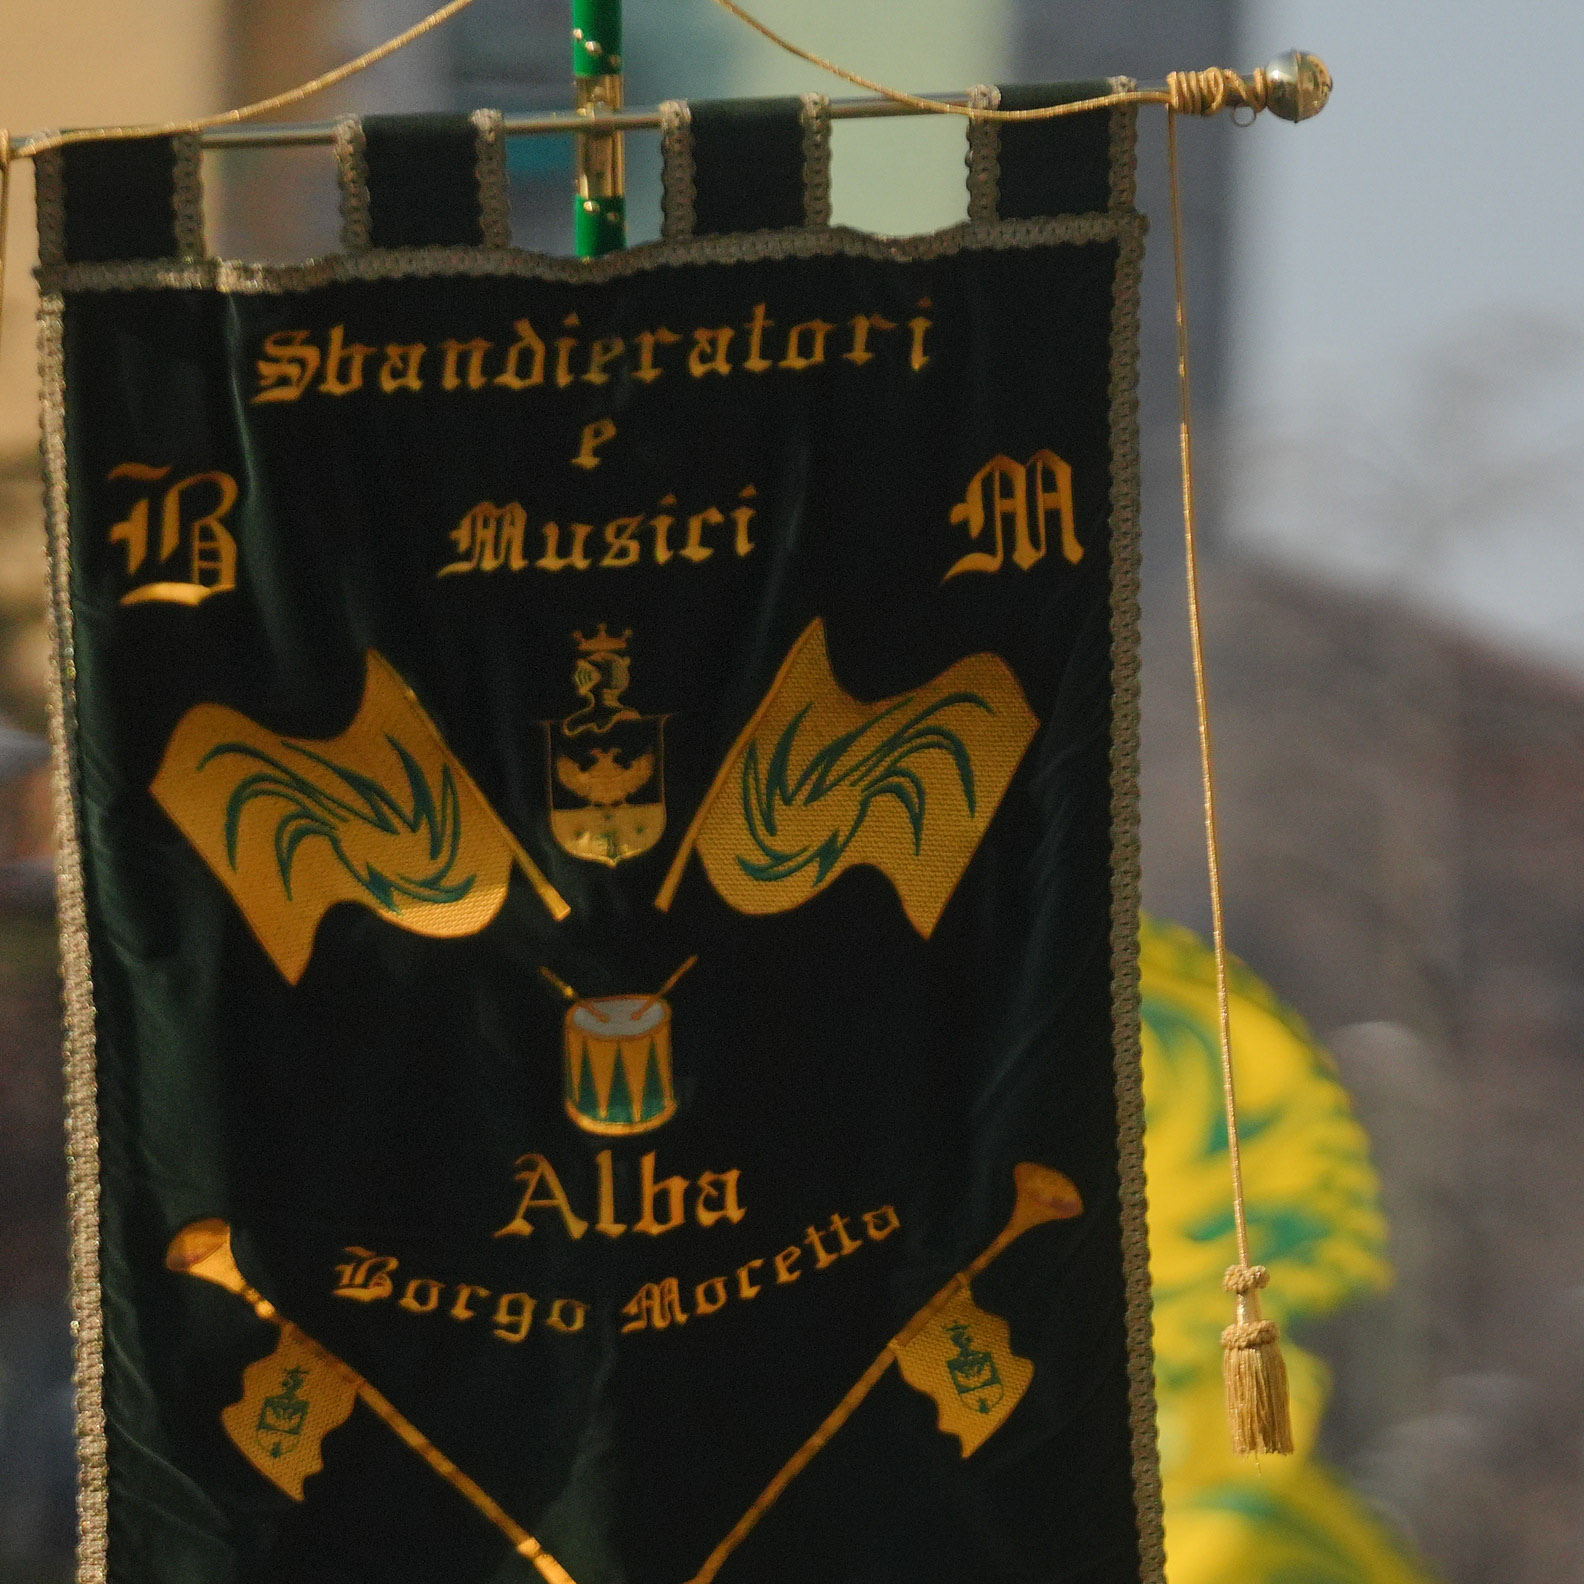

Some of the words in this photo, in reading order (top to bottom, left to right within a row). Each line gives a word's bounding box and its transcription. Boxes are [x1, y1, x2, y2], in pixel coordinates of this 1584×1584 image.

[252, 296, 938, 402] Sbandieratori
[571, 417, 618, 471] e
[106, 460, 240, 608] B
[437, 486, 759, 579] Musici
[939, 448, 1087, 587] M
[493, 1148, 749, 1240] Alba
[331, 1245, 588, 1343] Borgo
[620, 1204, 901, 1334] Moretto
